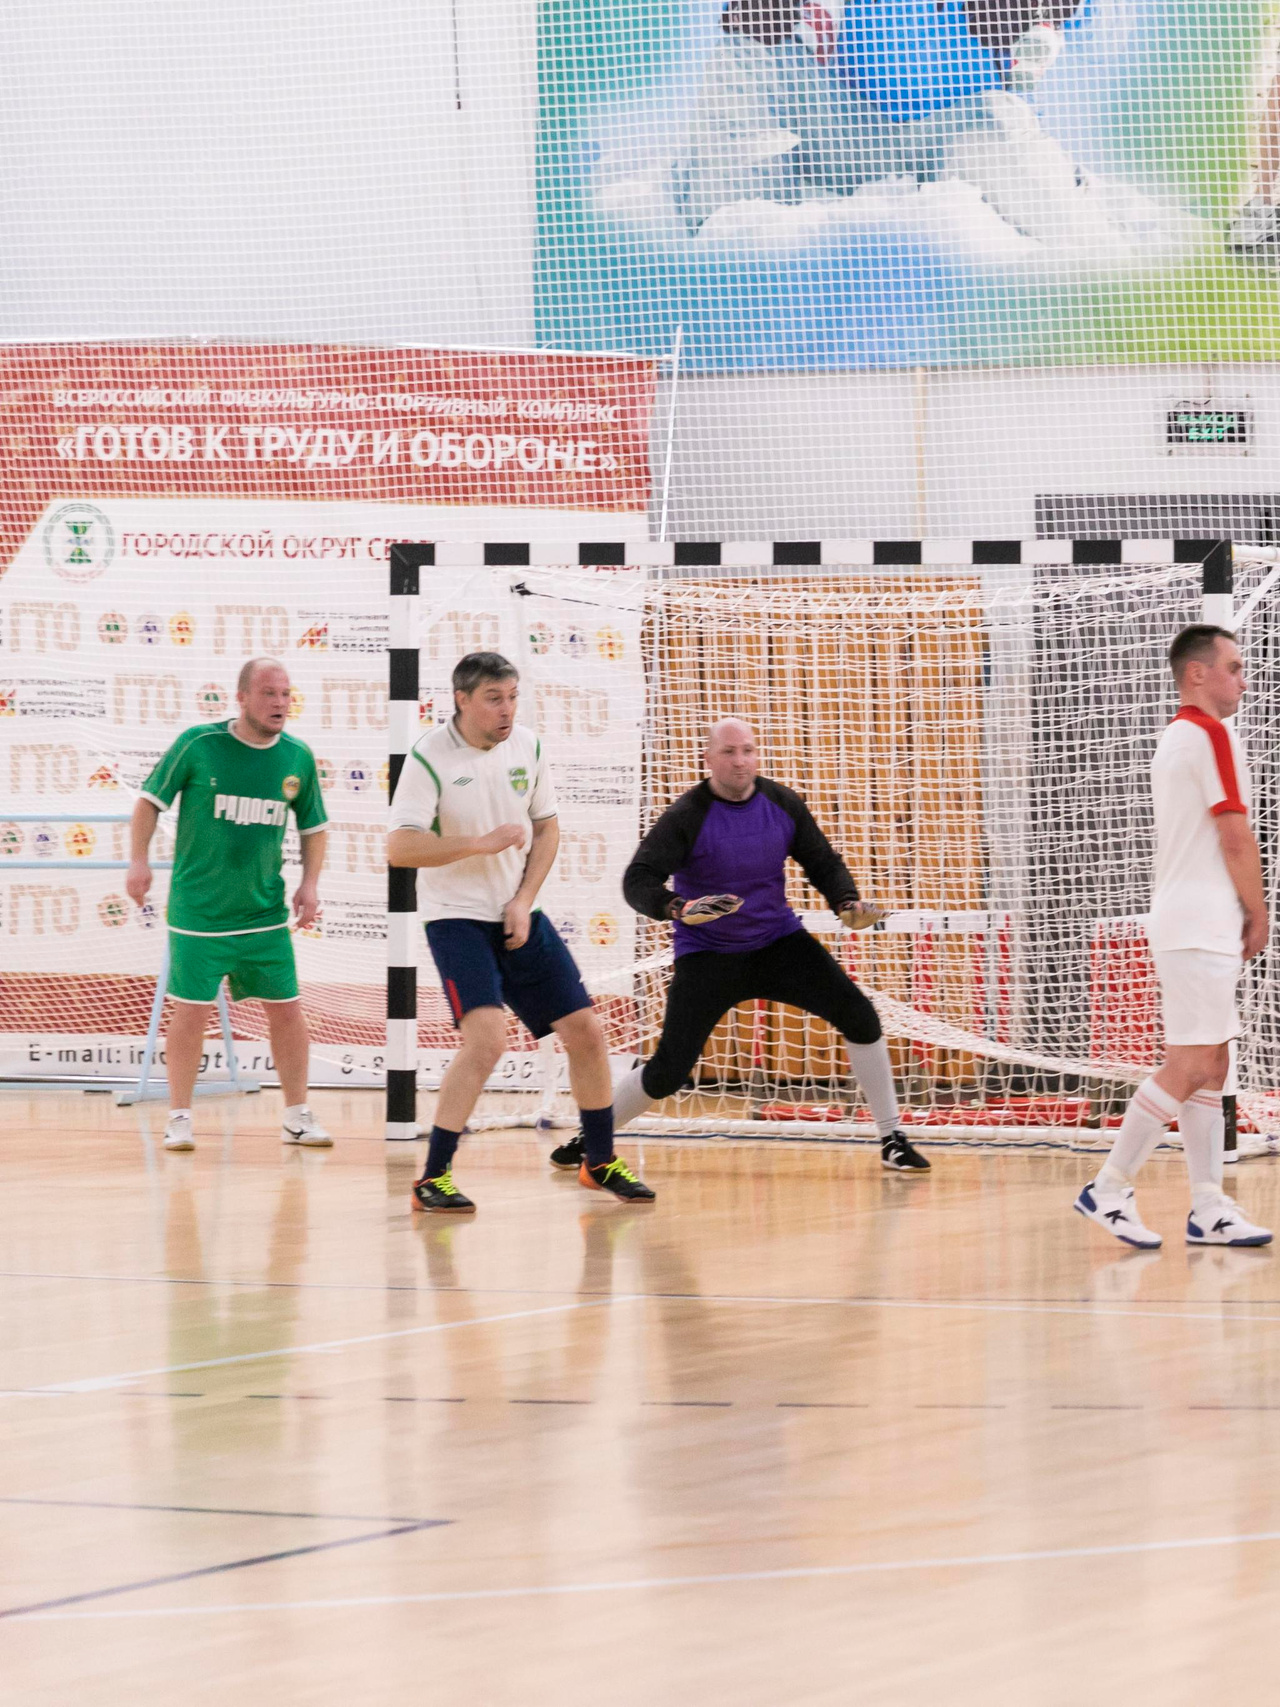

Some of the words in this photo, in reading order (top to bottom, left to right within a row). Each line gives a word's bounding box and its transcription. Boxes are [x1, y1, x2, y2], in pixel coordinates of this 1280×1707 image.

[55, 425, 193, 461] «ГОТОВ
[204, 425, 230, 461] К
[240, 427, 361, 469] ТРУДУ
[372, 430, 399, 465] И
[410, 431, 618, 473] ОБОРОНЕ»
[121, 530, 274, 559] ГОРОДСКОЙ
[282, 535, 362, 559] ОКРУГ
[29, 1043, 121, 1063] E-mail:
